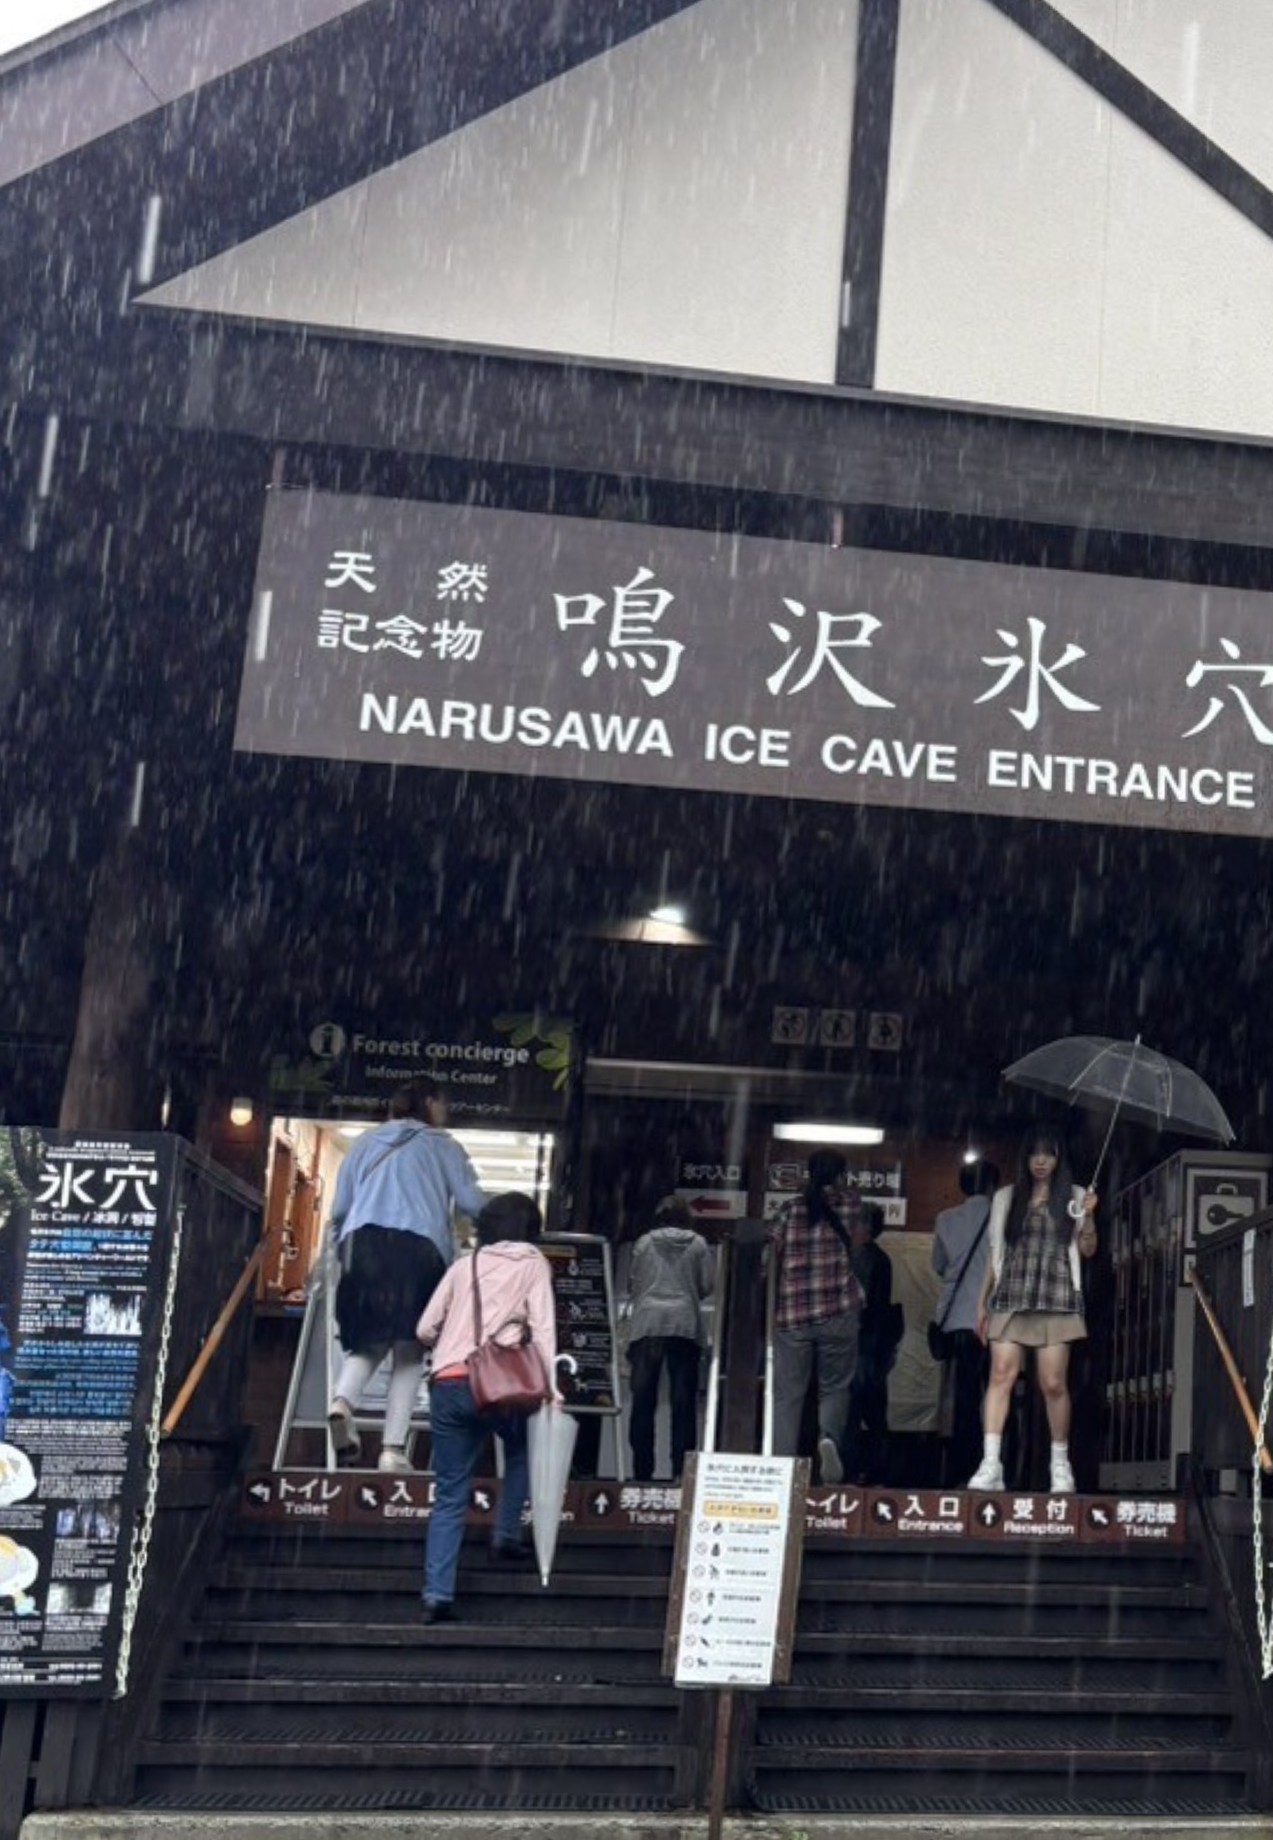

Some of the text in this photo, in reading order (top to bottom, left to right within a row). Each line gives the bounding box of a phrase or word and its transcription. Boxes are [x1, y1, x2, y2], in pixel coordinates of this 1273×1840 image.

[324, 549, 490, 604] 天然
[316, 608, 484, 662] 記念物
[358, 690, 1257, 809] NARUSAWA ICE CAVE ENTRANCE
[353, 1035, 530, 1067] Forest concierge
[451, 1069, 497, 1084] Center
[35, 1161, 159, 1211] 氷穴
[279, 1478, 342, 1500] トイレ
[620, 1487, 682, 1510] 券売機
[904, 1495, 960, 1517] 入口
[1117, 1501, 1177, 1523] 券売機
[284, 1501, 329, 1516] Toilet
[628, 1511, 675, 1525] Ticket
[805, 1515, 1169, 1538] Toilet Entrance Reception Ticket
